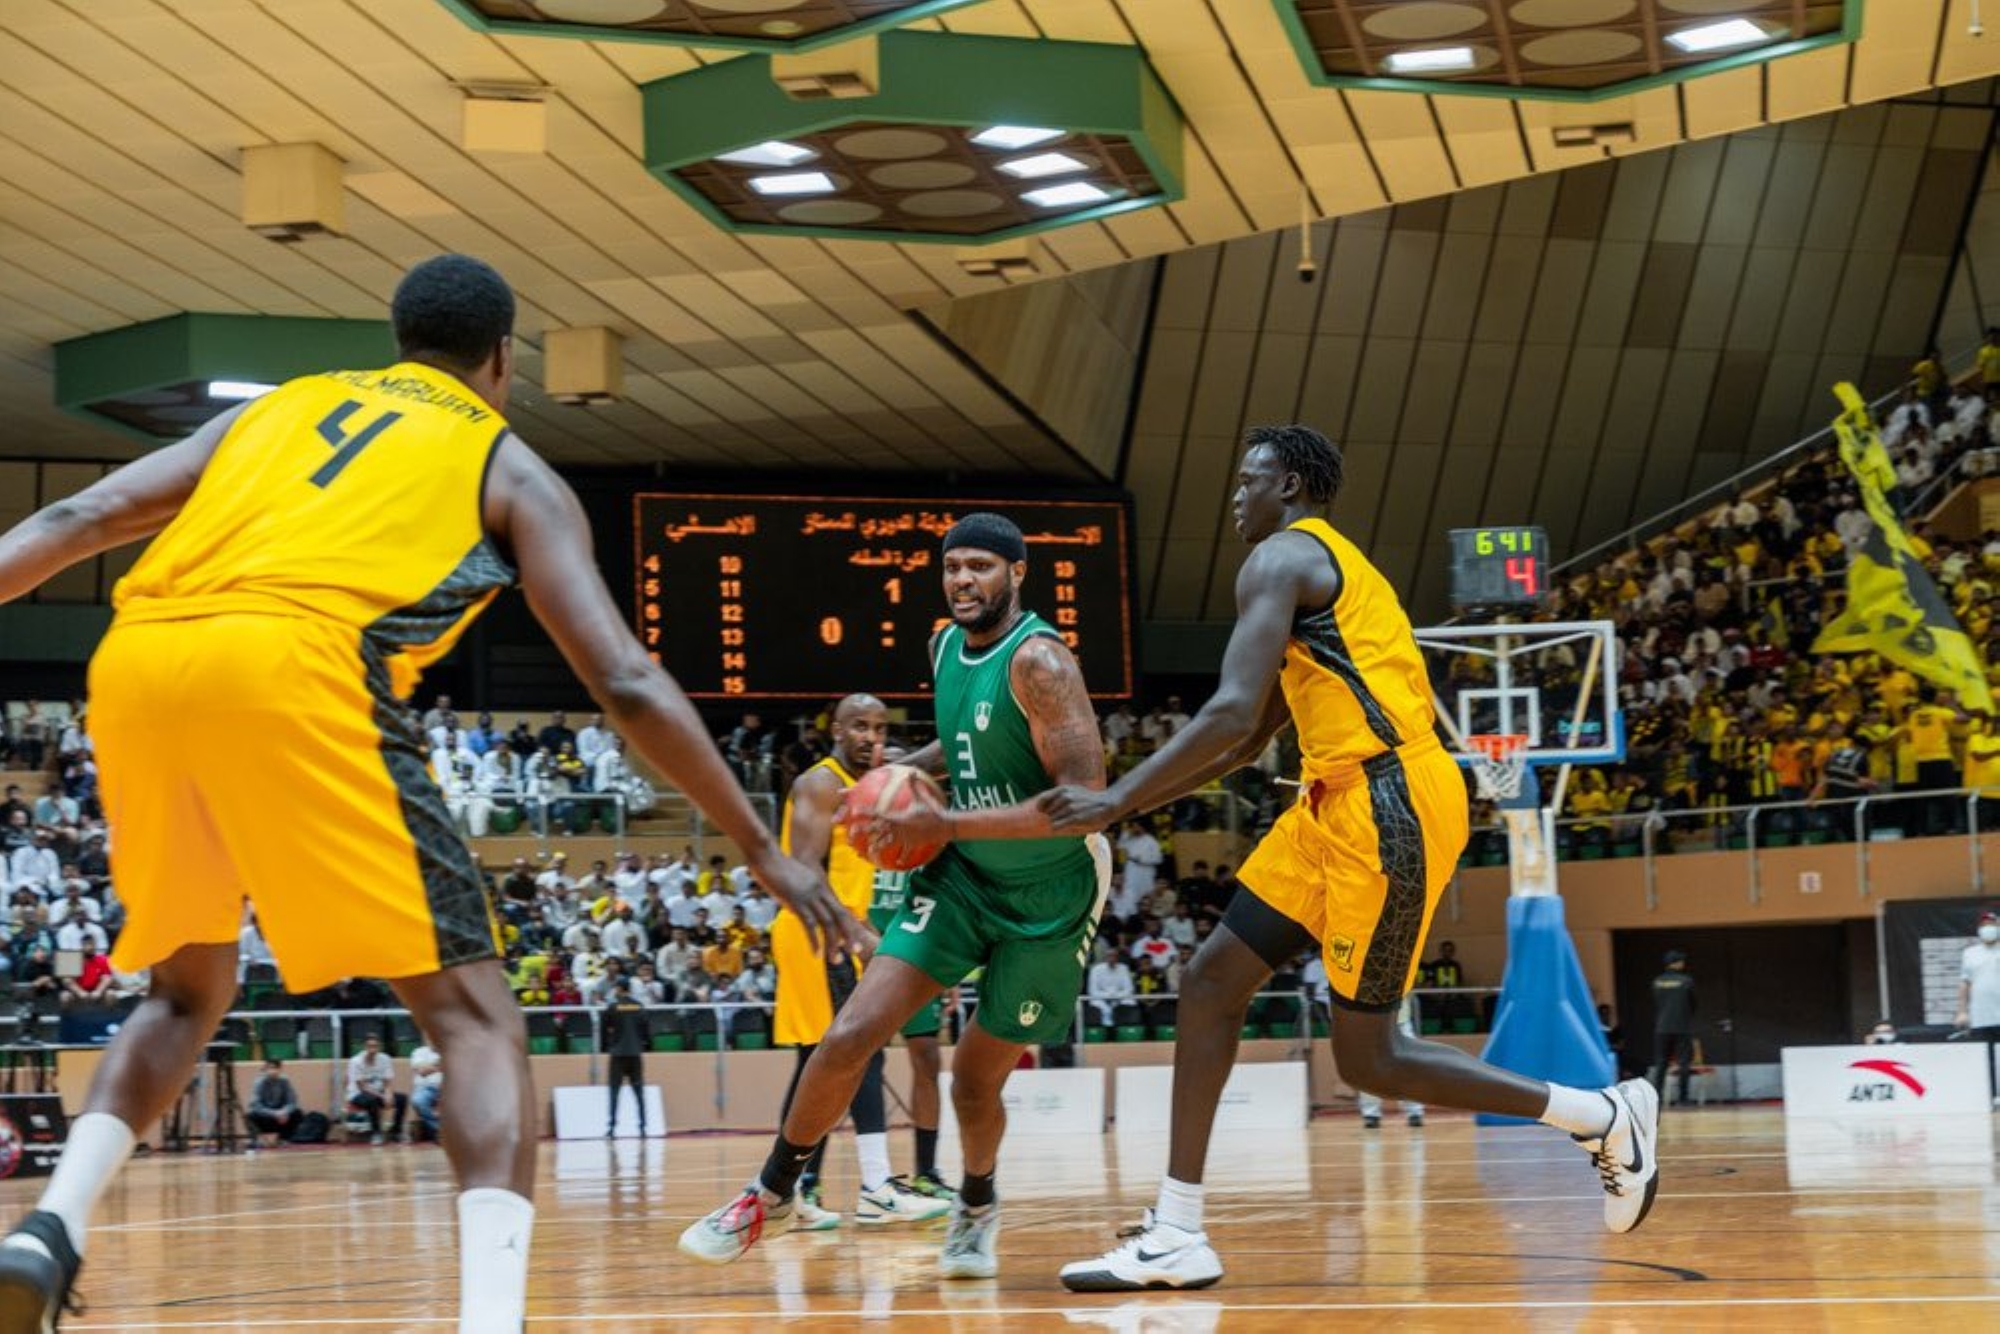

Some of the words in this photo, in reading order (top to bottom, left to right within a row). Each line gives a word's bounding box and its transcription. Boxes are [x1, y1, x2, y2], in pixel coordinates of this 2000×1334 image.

[309, 399, 404, 489] 4
[643, 554, 660, 573] 4
[719, 555, 742, 574] 10
[1505, 556, 1537, 596] 4
[719, 579, 742, 598] 11
[884, 577, 901, 604] 1
[1055, 584, 1076, 602] 11
[721, 603, 745, 622] 12
[1056, 607, 1078, 626] 12
[646, 627, 661, 646] 7
[721, 628, 745, 646] 13
[820, 616, 843, 645] 0
[1059, 630, 1079, 648] 3
[723, 651, 746, 670] 14
[956, 732, 977, 779] 3
[900, 895, 937, 934] 3
[1847, 1083, 1895, 1102] ANTA
